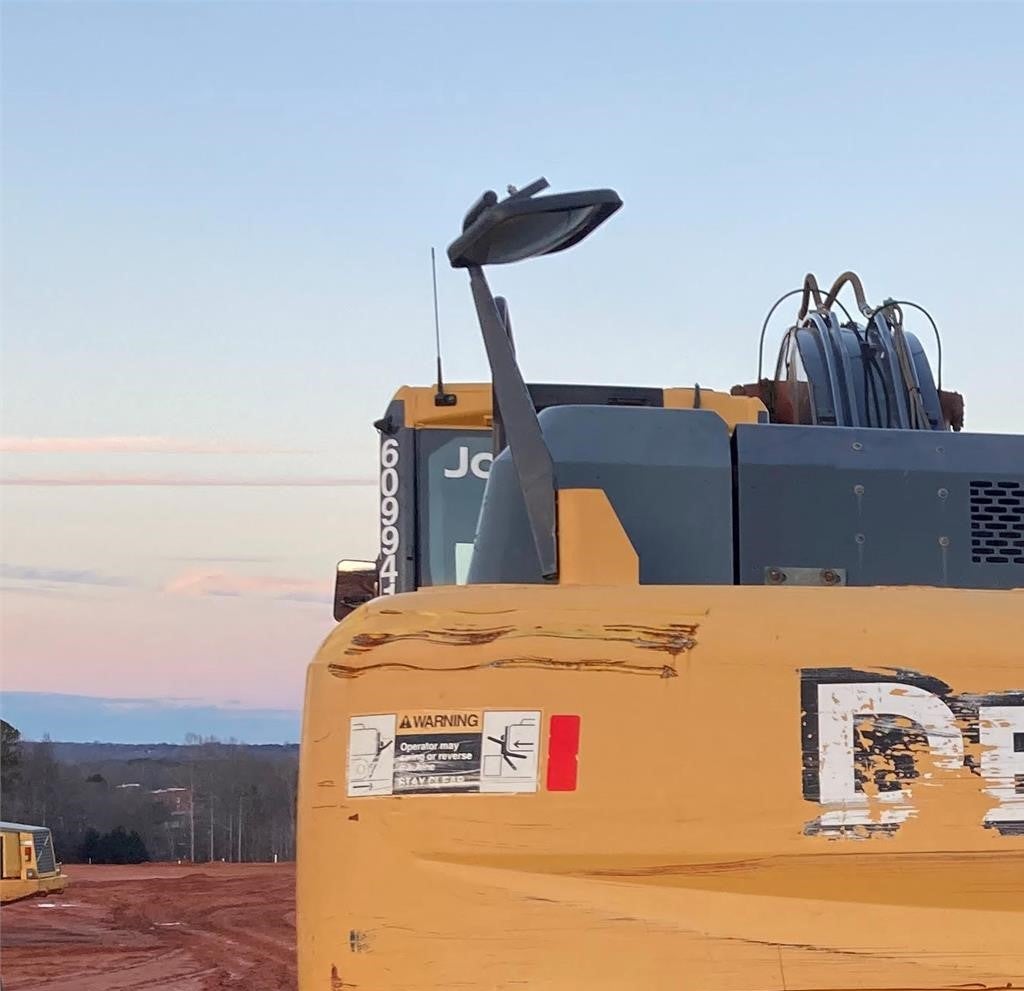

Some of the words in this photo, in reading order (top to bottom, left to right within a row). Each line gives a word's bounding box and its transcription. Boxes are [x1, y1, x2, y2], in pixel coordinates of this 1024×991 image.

[414, 714, 479, 729] WARNING
[400, 742, 438, 752] Operator
[440, 742, 460, 752] may
[438, 752, 473, 761] reverse
